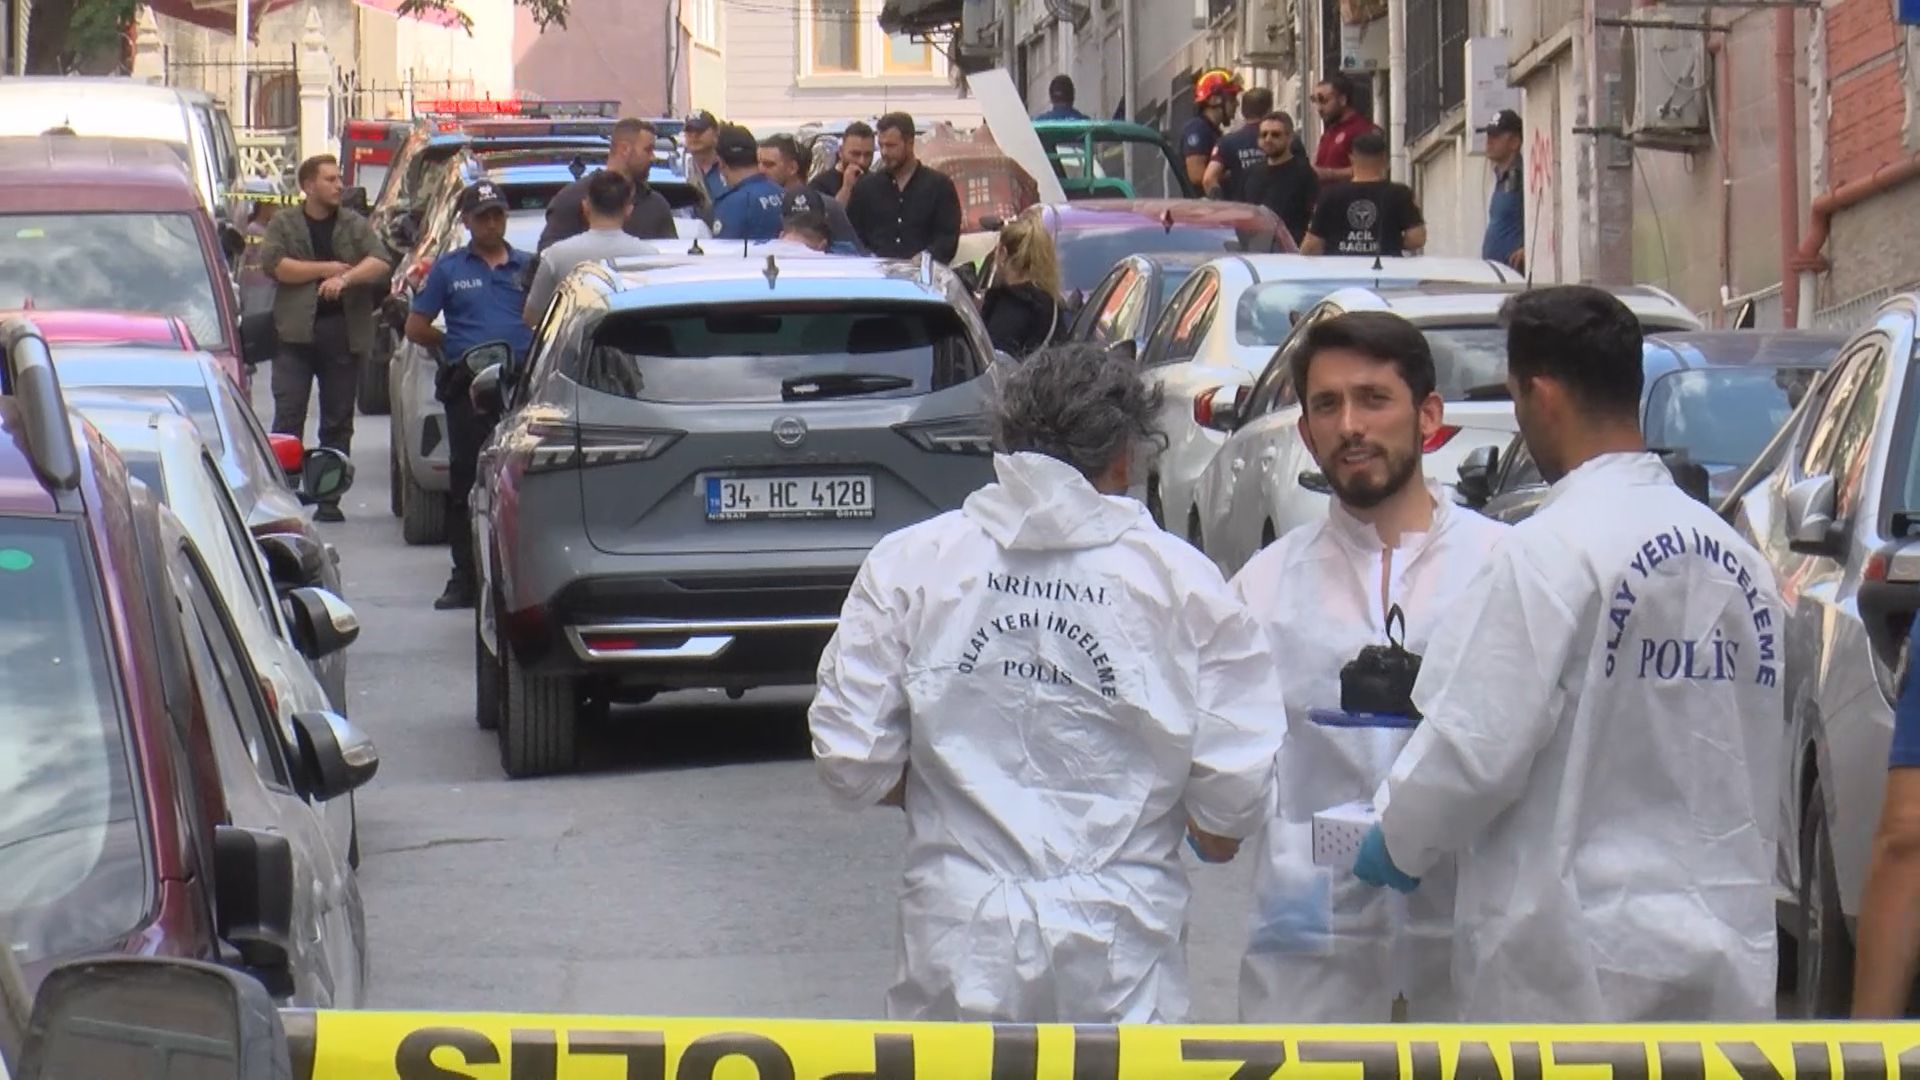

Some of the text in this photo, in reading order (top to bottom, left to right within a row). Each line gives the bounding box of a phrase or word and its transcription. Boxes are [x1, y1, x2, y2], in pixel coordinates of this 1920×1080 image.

[724, 480, 866, 508] 34 HC 4128
[987, 572, 1112, 606] KRİMİNAL
[1605, 580, 1637, 678] OLAY
[958, 608, 1117, 698] OLAY YERİ İNCELEME
[1003, 660, 1073, 685] POLİS
[1638, 629, 1740, 681] POLİS
